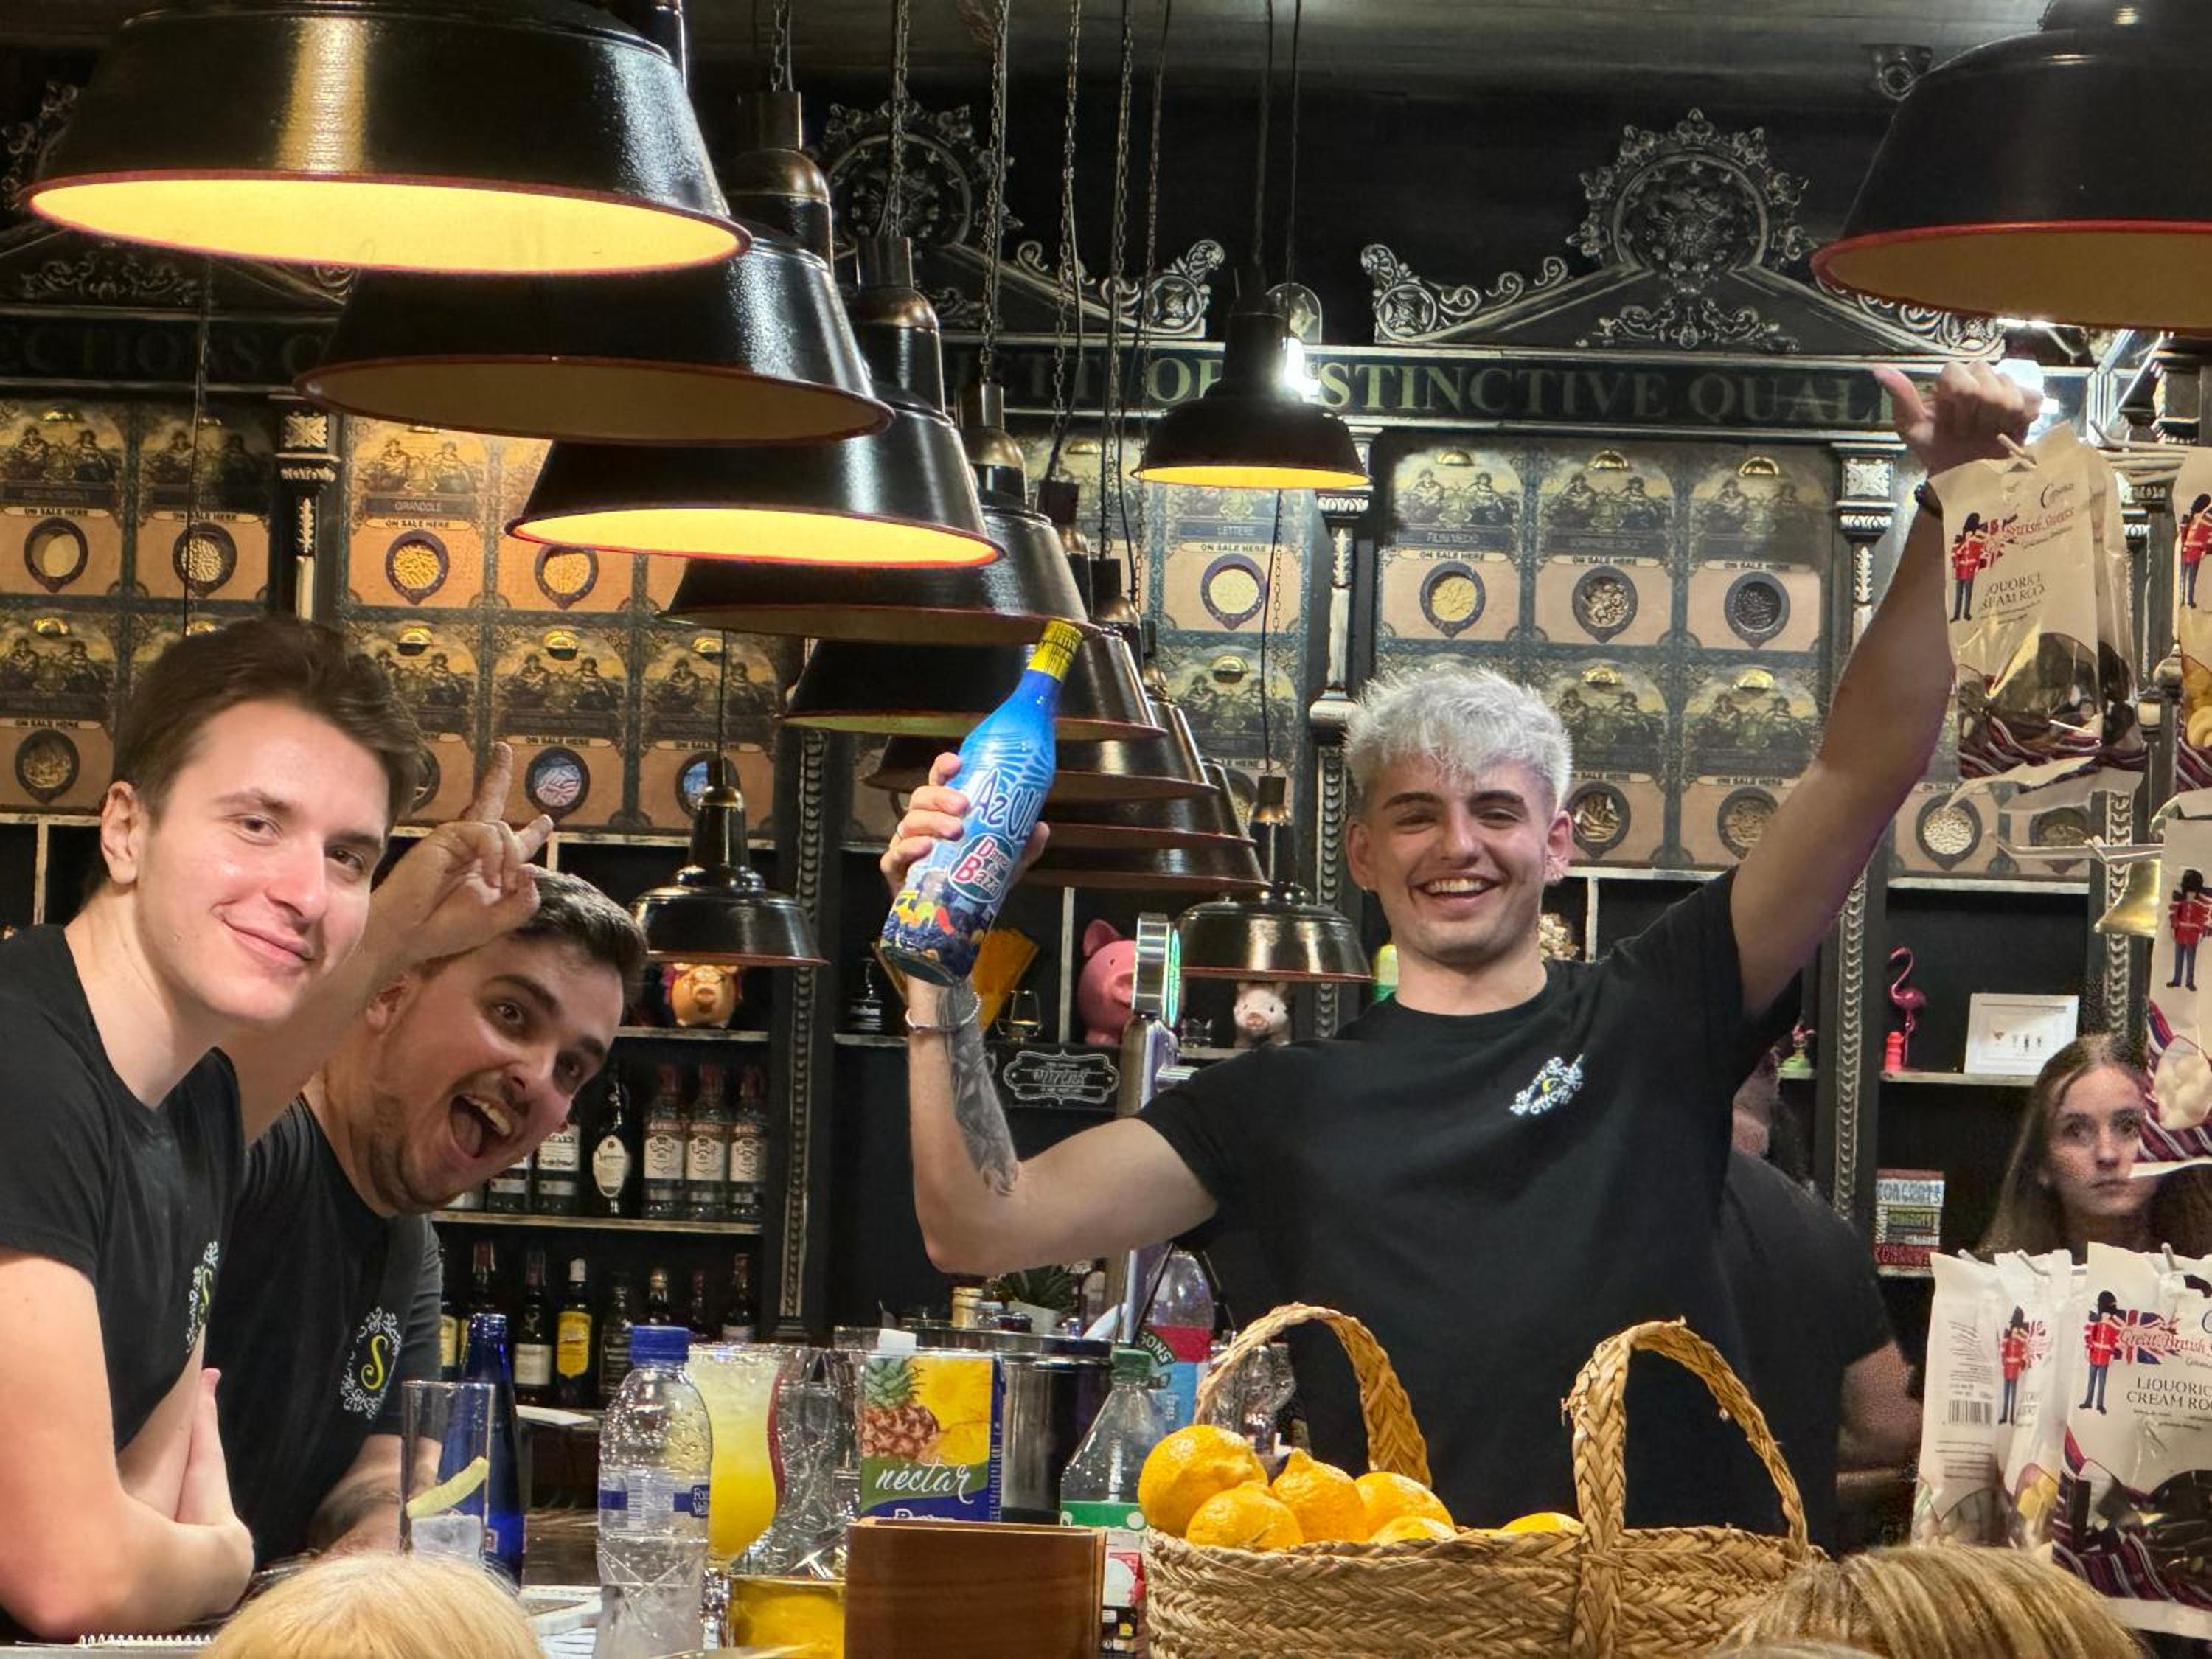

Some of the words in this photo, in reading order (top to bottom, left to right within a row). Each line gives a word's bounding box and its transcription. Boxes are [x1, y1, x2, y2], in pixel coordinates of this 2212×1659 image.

[1319, 361, 1669, 418] STINCTIVE
[1688, 371, 1896, 425] QUALI
[2126, 1391, 2183, 1408] CREAM
[875, 1458, 975, 1505] néctar
